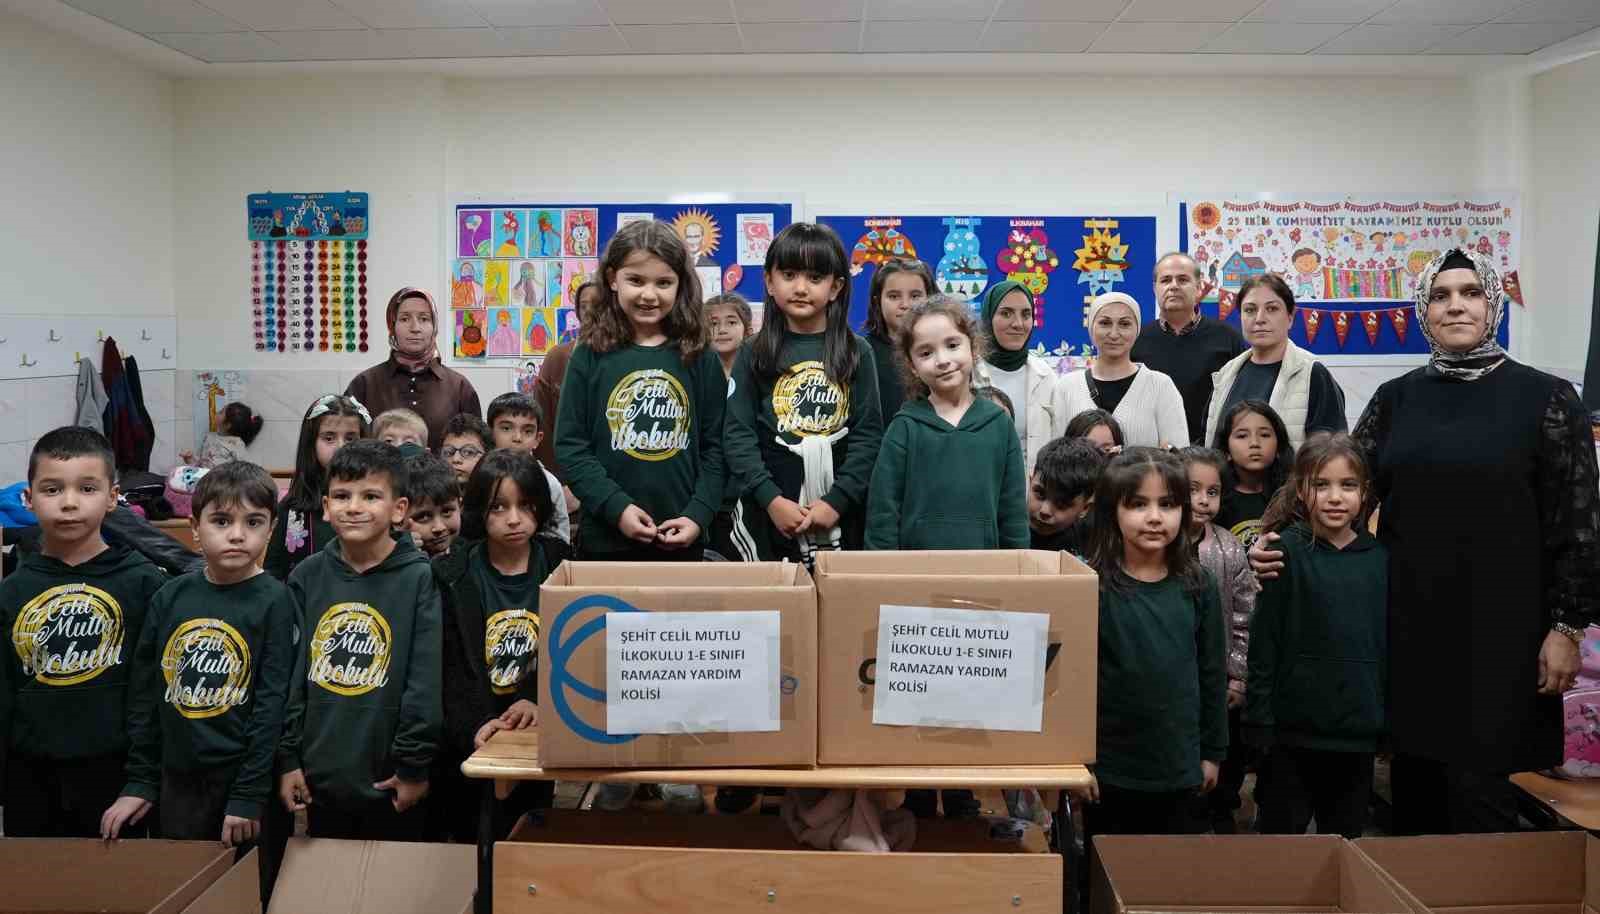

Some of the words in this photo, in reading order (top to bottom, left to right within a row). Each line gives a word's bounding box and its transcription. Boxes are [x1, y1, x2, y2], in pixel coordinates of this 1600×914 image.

[1426, 216, 1462, 226] KUTLU
[1467, 216, 1503, 226] OLSUN
[621, 628, 656, 644] ŞEHİT
[660, 628, 692, 642] CELİL
[695, 630, 741, 642] MUTLU
[892, 623, 927, 637] ŞEHİT
[930, 625, 961, 639] CELİL
[964, 628, 1009, 641] MUTLU
[621, 649, 684, 662] İLKOKULU
[687, 650, 707, 661] 1-E
[710, 649, 745, 661] SINIFI
[891, 641, 953, 657] İLKOKULU
[955, 647, 974, 658] 1-E
[977, 647, 1013, 660] SINIFI
[621, 669, 687, 681] RAMAZAN
[690, 669, 741, 680] YARDIM
[889, 662, 954, 676] RAMAZAN
[957, 665, 1008, 678] YARDIM
[888, 680, 928, 693] KOLİSİ
[620, 687, 661, 700] KOLİSİ
